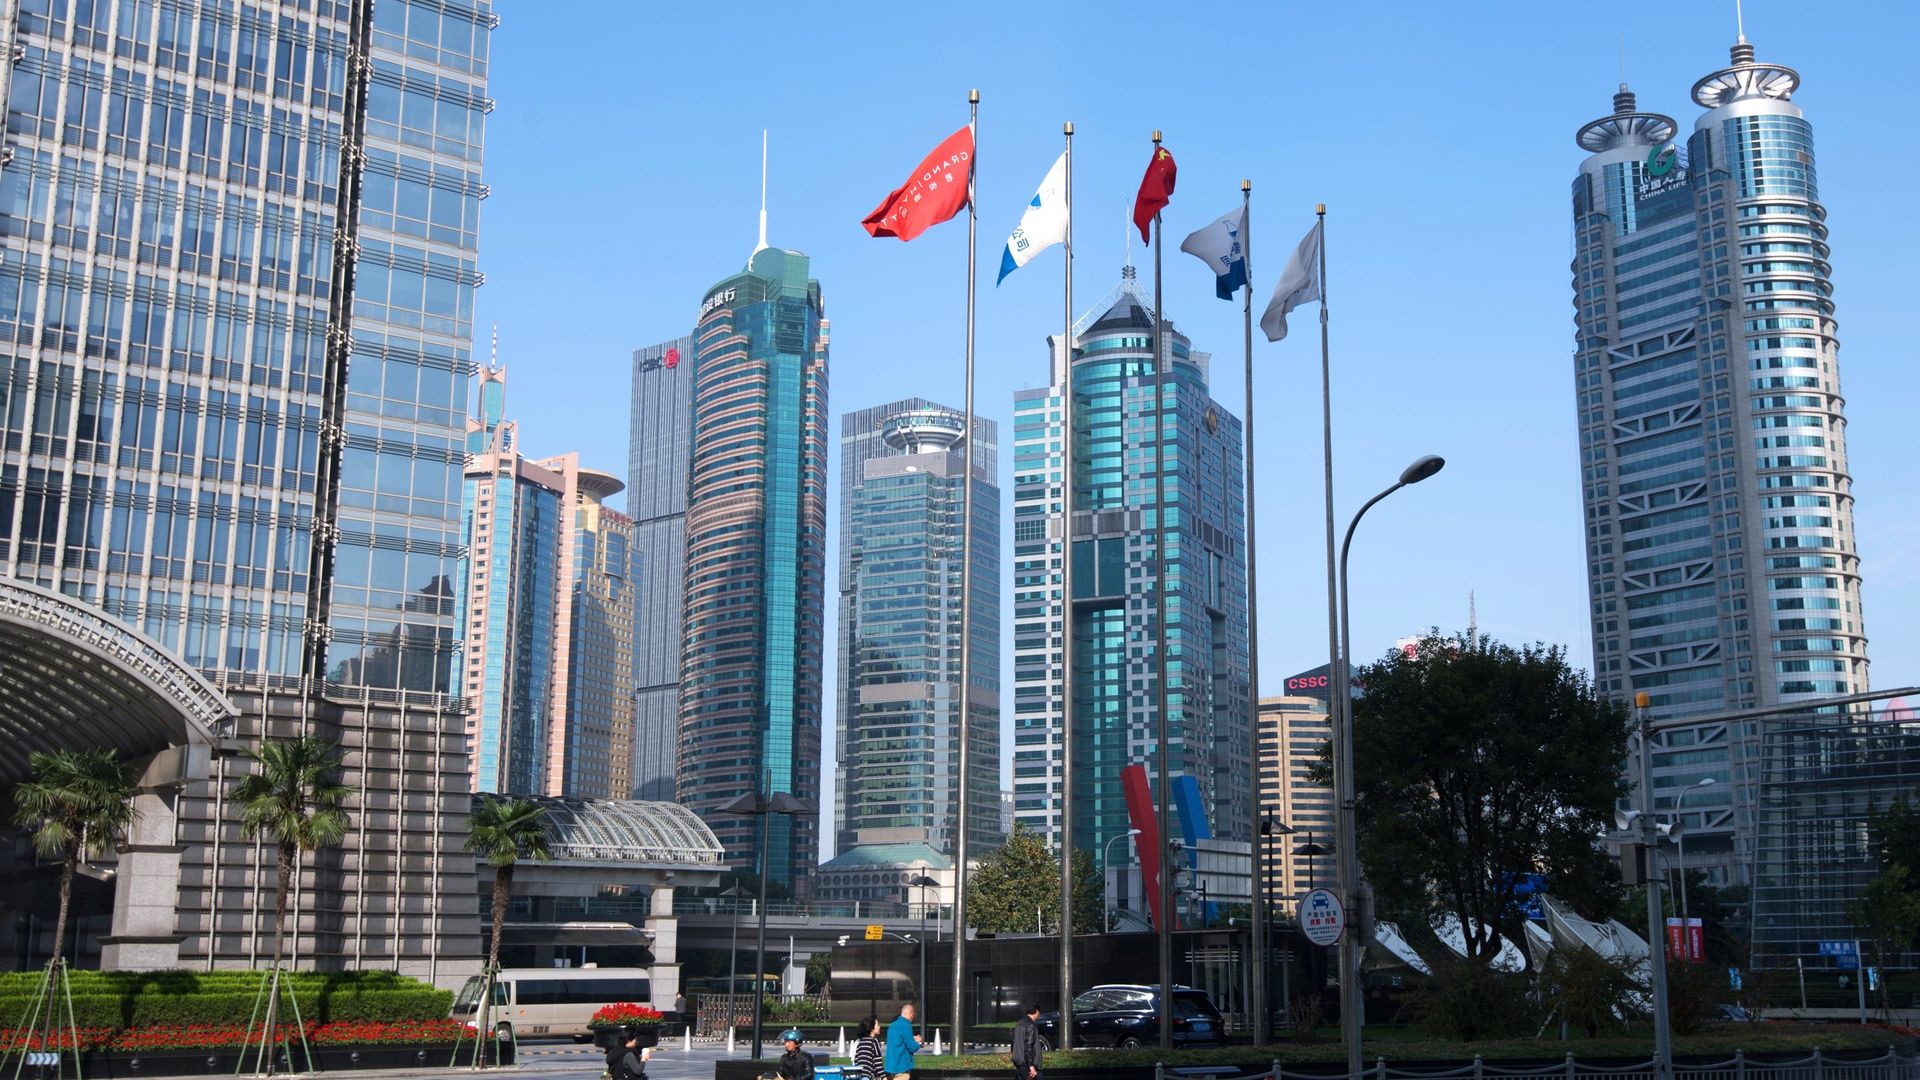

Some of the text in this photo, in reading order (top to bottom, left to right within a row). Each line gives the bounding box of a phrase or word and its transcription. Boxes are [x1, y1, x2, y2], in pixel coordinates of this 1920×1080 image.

[1640, 181, 1687, 201] CHINA LIFE
[1288, 675, 1328, 689] CSSC
